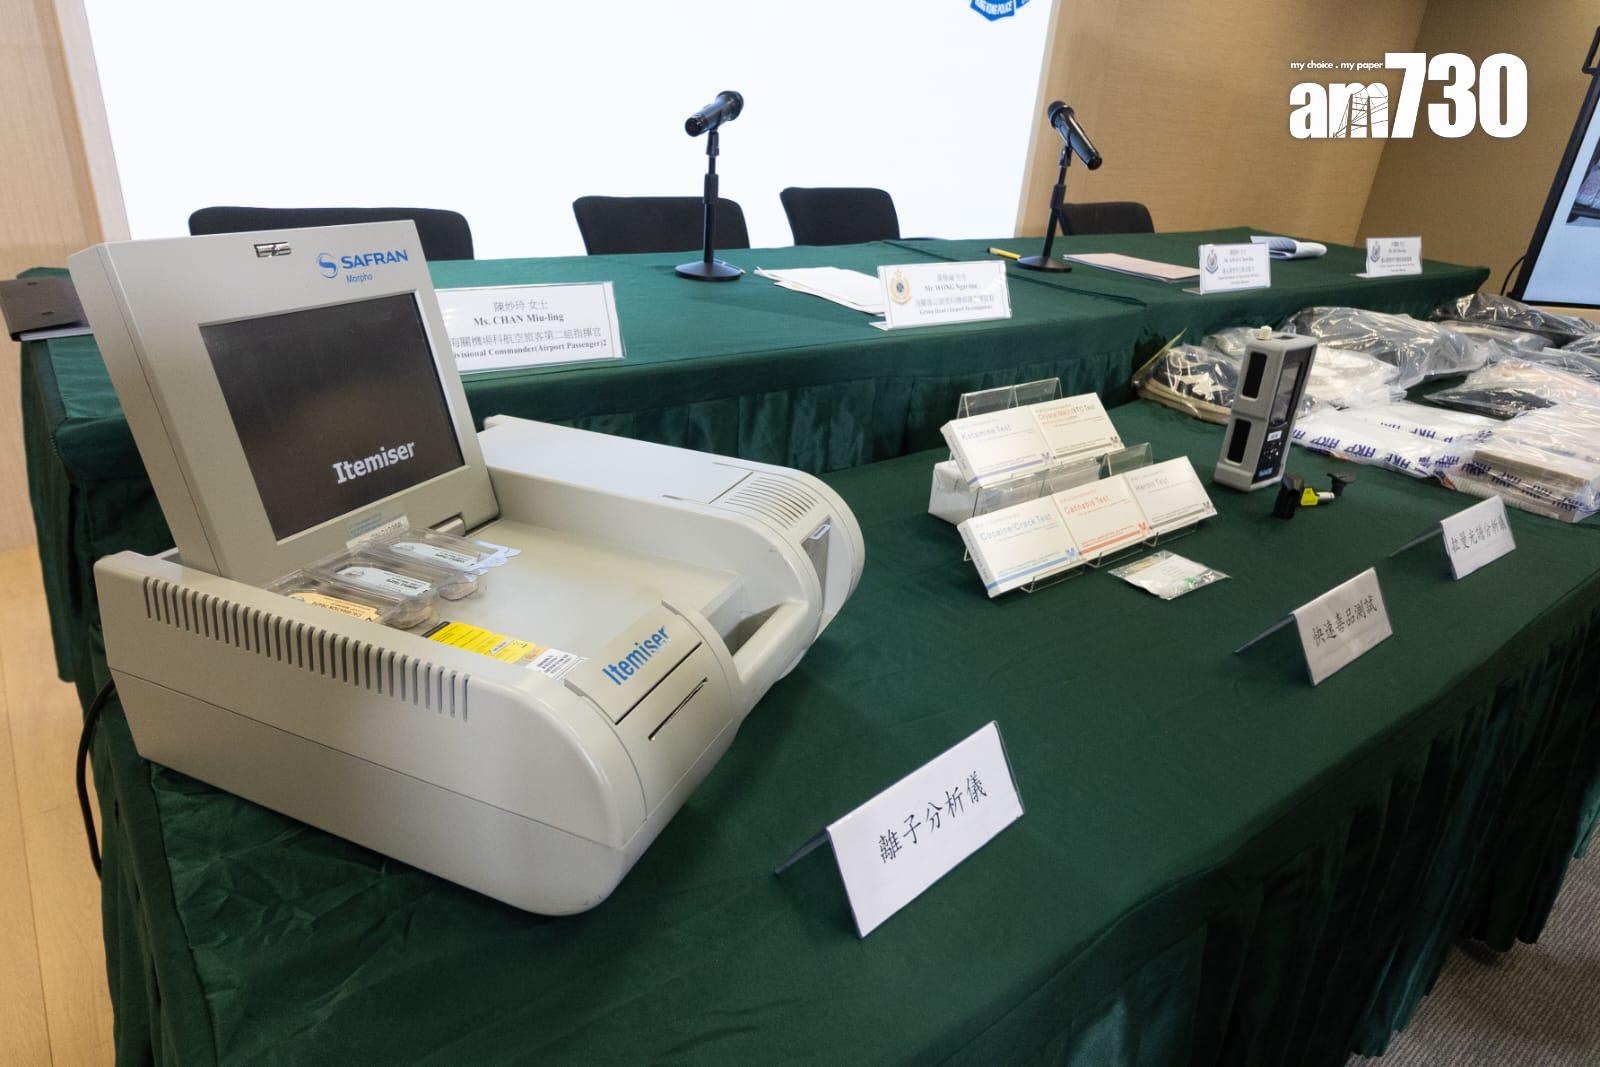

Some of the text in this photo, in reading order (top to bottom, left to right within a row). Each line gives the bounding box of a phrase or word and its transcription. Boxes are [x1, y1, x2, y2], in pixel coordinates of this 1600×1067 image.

[340, 249, 409, 270] SAFRAN
[345, 273, 374, 284] Morpho
[474, 312, 565, 326] Ms. CHAN Miu-ling
[454, 348, 487, 358] ivisional
[995, 424, 1013, 433] Test
[332, 441, 415, 484] Itemiser
[1064, 499, 1096, 514] Cannabis
[1096, 495, 1110, 504] Test
[1035, 513, 1052, 524] Test
[1312, 595, 1378, 648] 快速毒品測試
[602, 625, 669, 686] Itemiser
[878, 770, 988, 864] 離子分析儀
